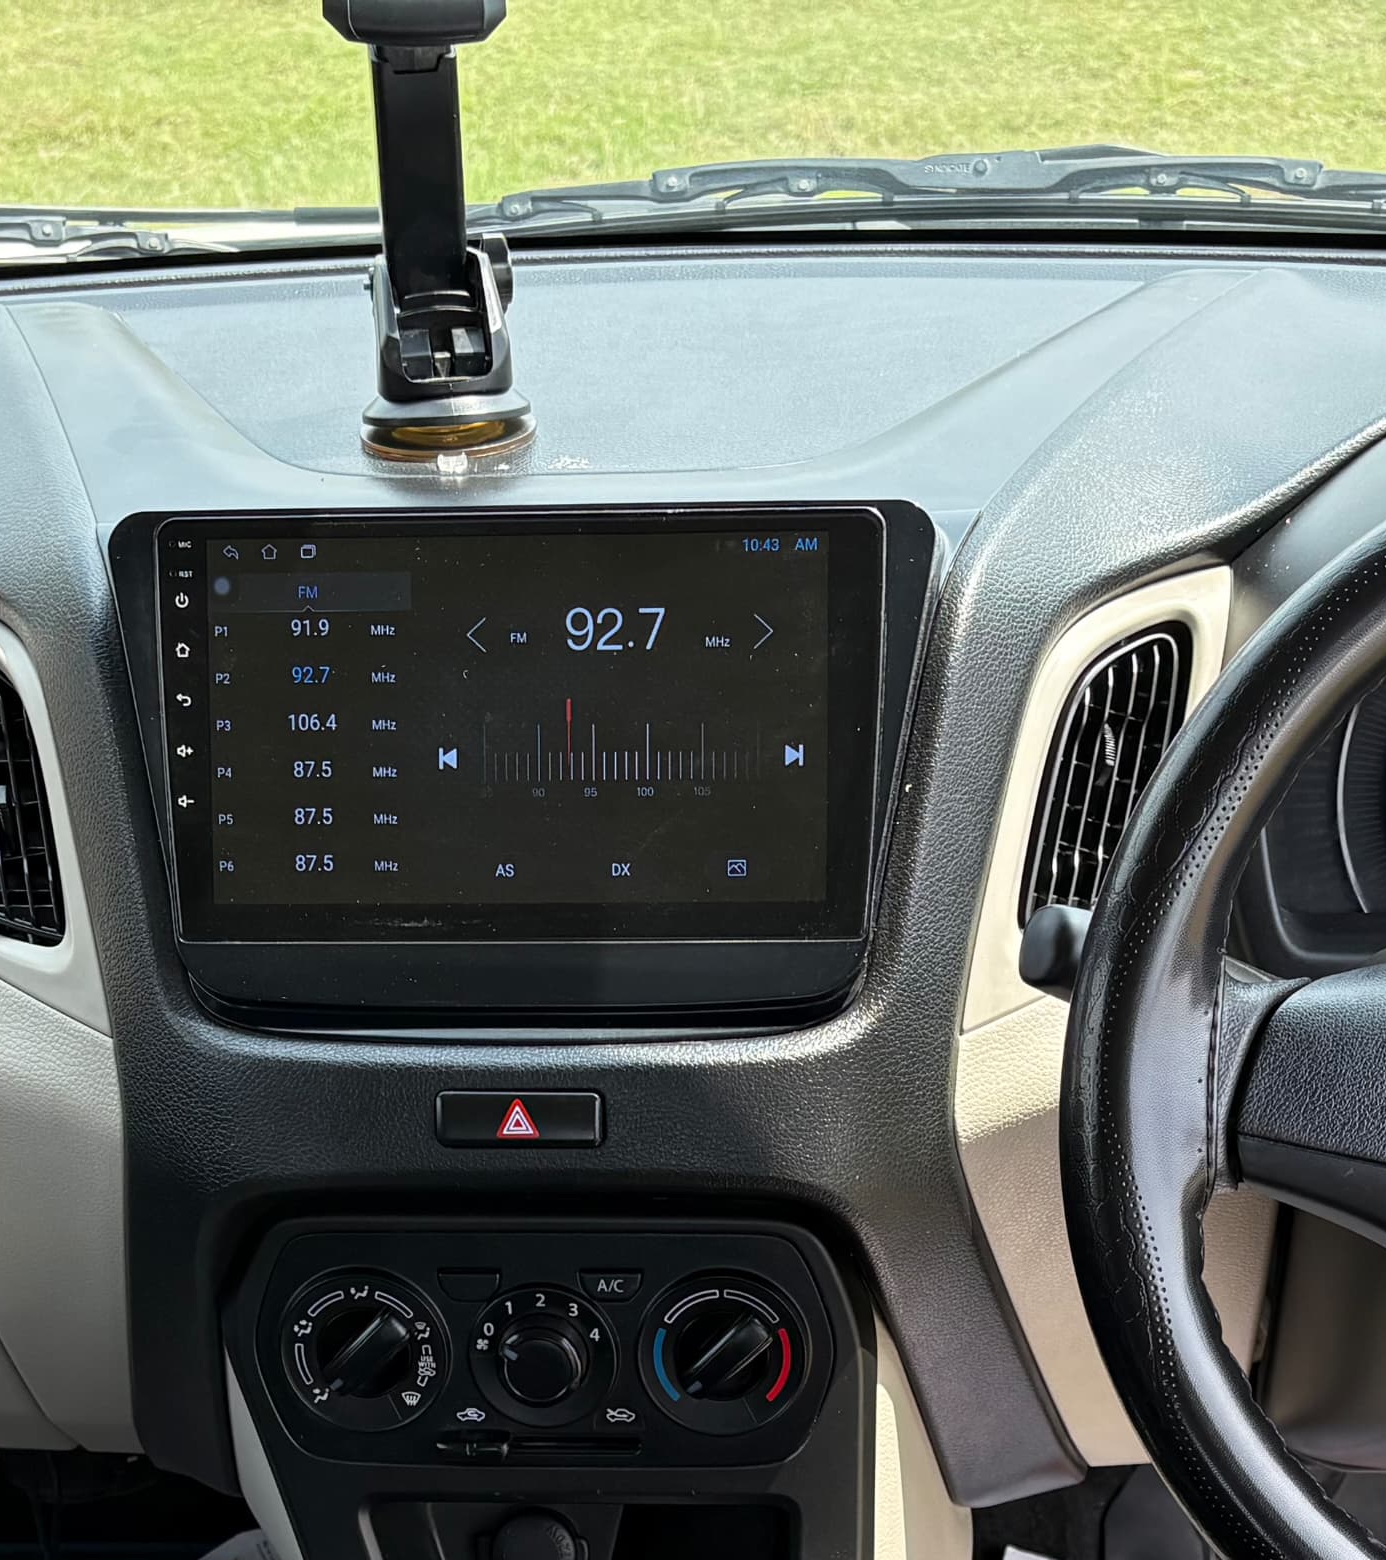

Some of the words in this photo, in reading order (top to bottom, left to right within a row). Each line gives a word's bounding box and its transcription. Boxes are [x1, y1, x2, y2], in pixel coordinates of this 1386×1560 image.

[177, 540, 193, 549] MIC
[742, 538, 781, 552] 10:43
[795, 538, 819, 551] AM
[298, 585, 319, 600] FM
[214, 626, 229, 638] P1
[290, 618, 331, 637] 91.9
[370, 624, 396, 636] MHz
[510, 632, 528, 645] FM
[565, 607, 667, 652] 92.7
[705, 636, 731, 650] MHz
[215, 673, 231, 685] P2
[292, 666, 331, 684] 92.7
[371, 672, 397, 684] MHz
[216, 720, 231, 731] P3
[288, 713, 338, 731] 106.4
[372, 719, 397, 731] MHz
[217, 767, 232, 779] P4
[293, 761, 333, 778] 87.5
[372, 767, 398, 778] MHz
[532, 787, 546, 798] 90
[584, 787, 598, 798] 95
[636, 786, 655, 798] 100
[693, 786, 712, 798] 105
[218, 814, 234, 825] P5
[294, 808, 334, 825] 87.5
[373, 814, 398, 825] MHz
[219, 860, 235, 872] P6
[295, 854, 334, 872] 87.5
[374, 860, 399, 872] MHz
[495, 863, 516, 878] AS
[612, 863, 631, 877] DX
[596, 1277, 625, 1295] A/C
[534, 1293, 546, 1308] 2
[504, 1301, 513, 1316] 1
[568, 1303, 579, 1318] 3
[482, 1322, 494, 1338] 0
[588, 1327, 601, 1343] 4
[417, 1361, 437, 1369] WITH
[420, 1354, 434, 1362] USE
